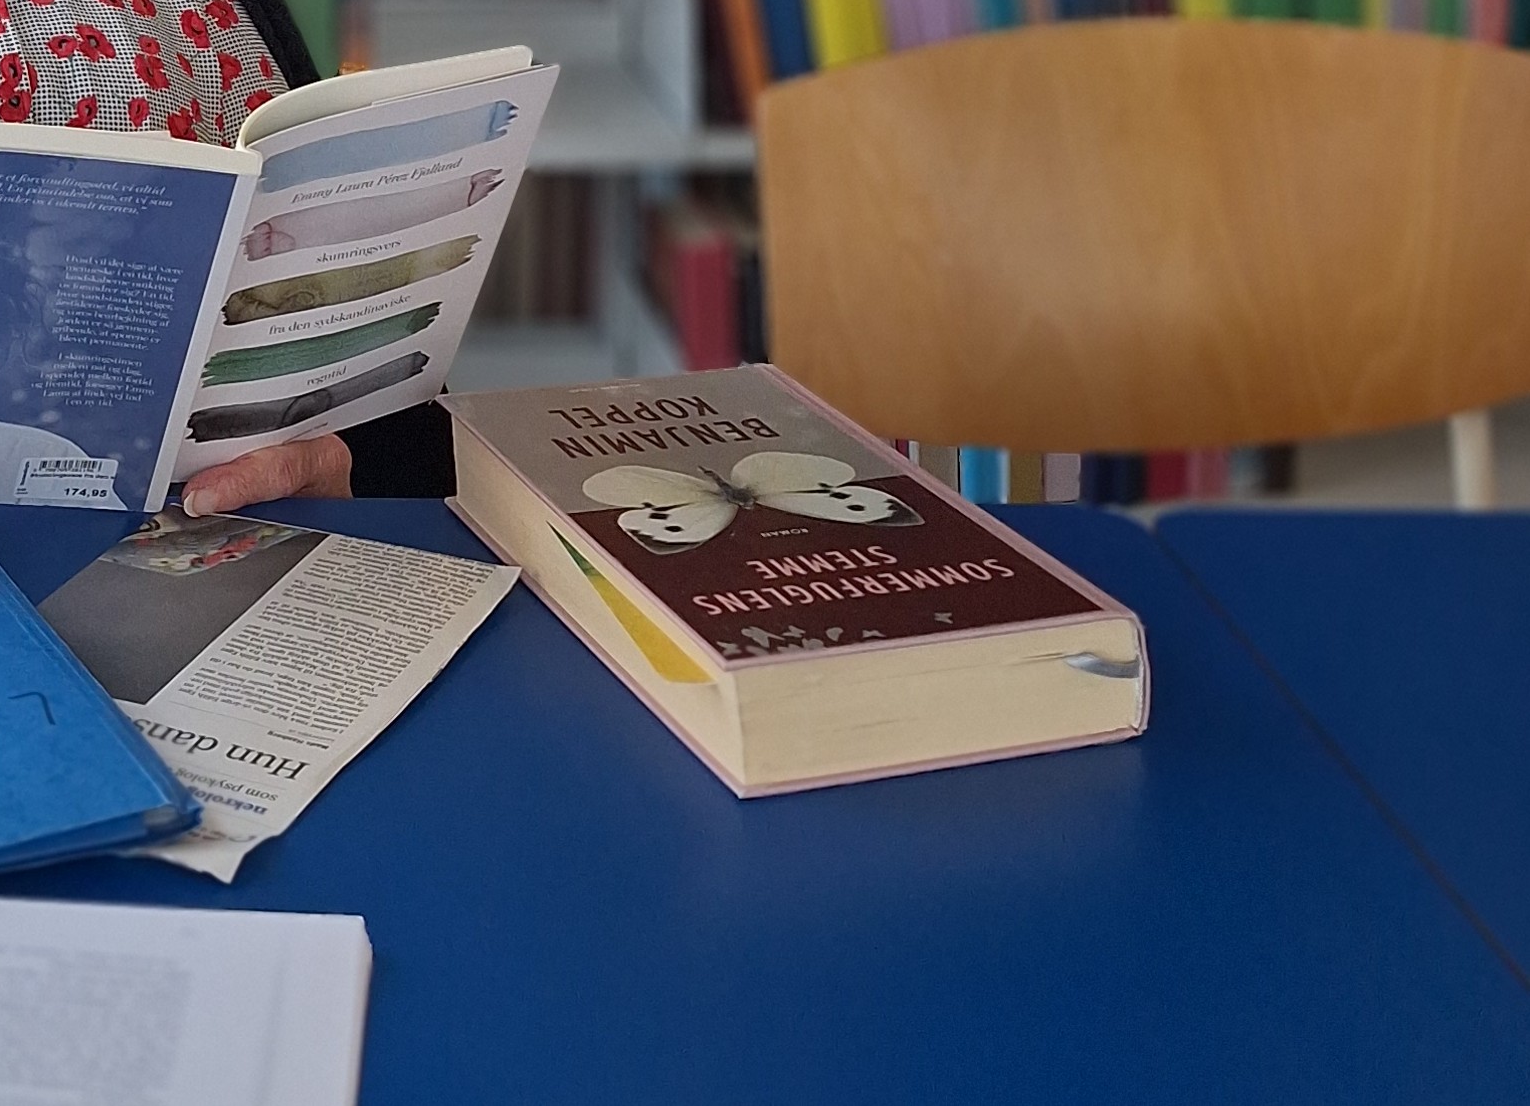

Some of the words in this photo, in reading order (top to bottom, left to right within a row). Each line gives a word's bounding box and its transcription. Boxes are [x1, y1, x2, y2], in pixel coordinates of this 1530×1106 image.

[291, 189, 333, 204] Emmy
[336, 180, 374, 194] Laura
[376, 173, 410, 187] Pérez
[410, 157, 463, 180] Fjalland
[315, 240, 402, 263] skumringsvers
[269, 321, 286, 335] fra
[288, 320, 311, 332] den
[313, 295, 412, 328] sydskandinaviske
[306, 366, 347, 386] regntid
[547, 395, 719, 430] KOPPEL
[551, 416, 781, 460] BENJAMIN
[64, 488, 108, 498] 174,95
[760, 527, 809, 538] ROMAN
[745, 544, 898, 580] STEMME
[691, 557, 1015, 617] SOMMERFUGLENS
[131, 717, 219, 755] dans
[225, 743, 311, 781] Hun
[175, 766, 244, 795] psykolog
[244, 788, 279, 803] som
